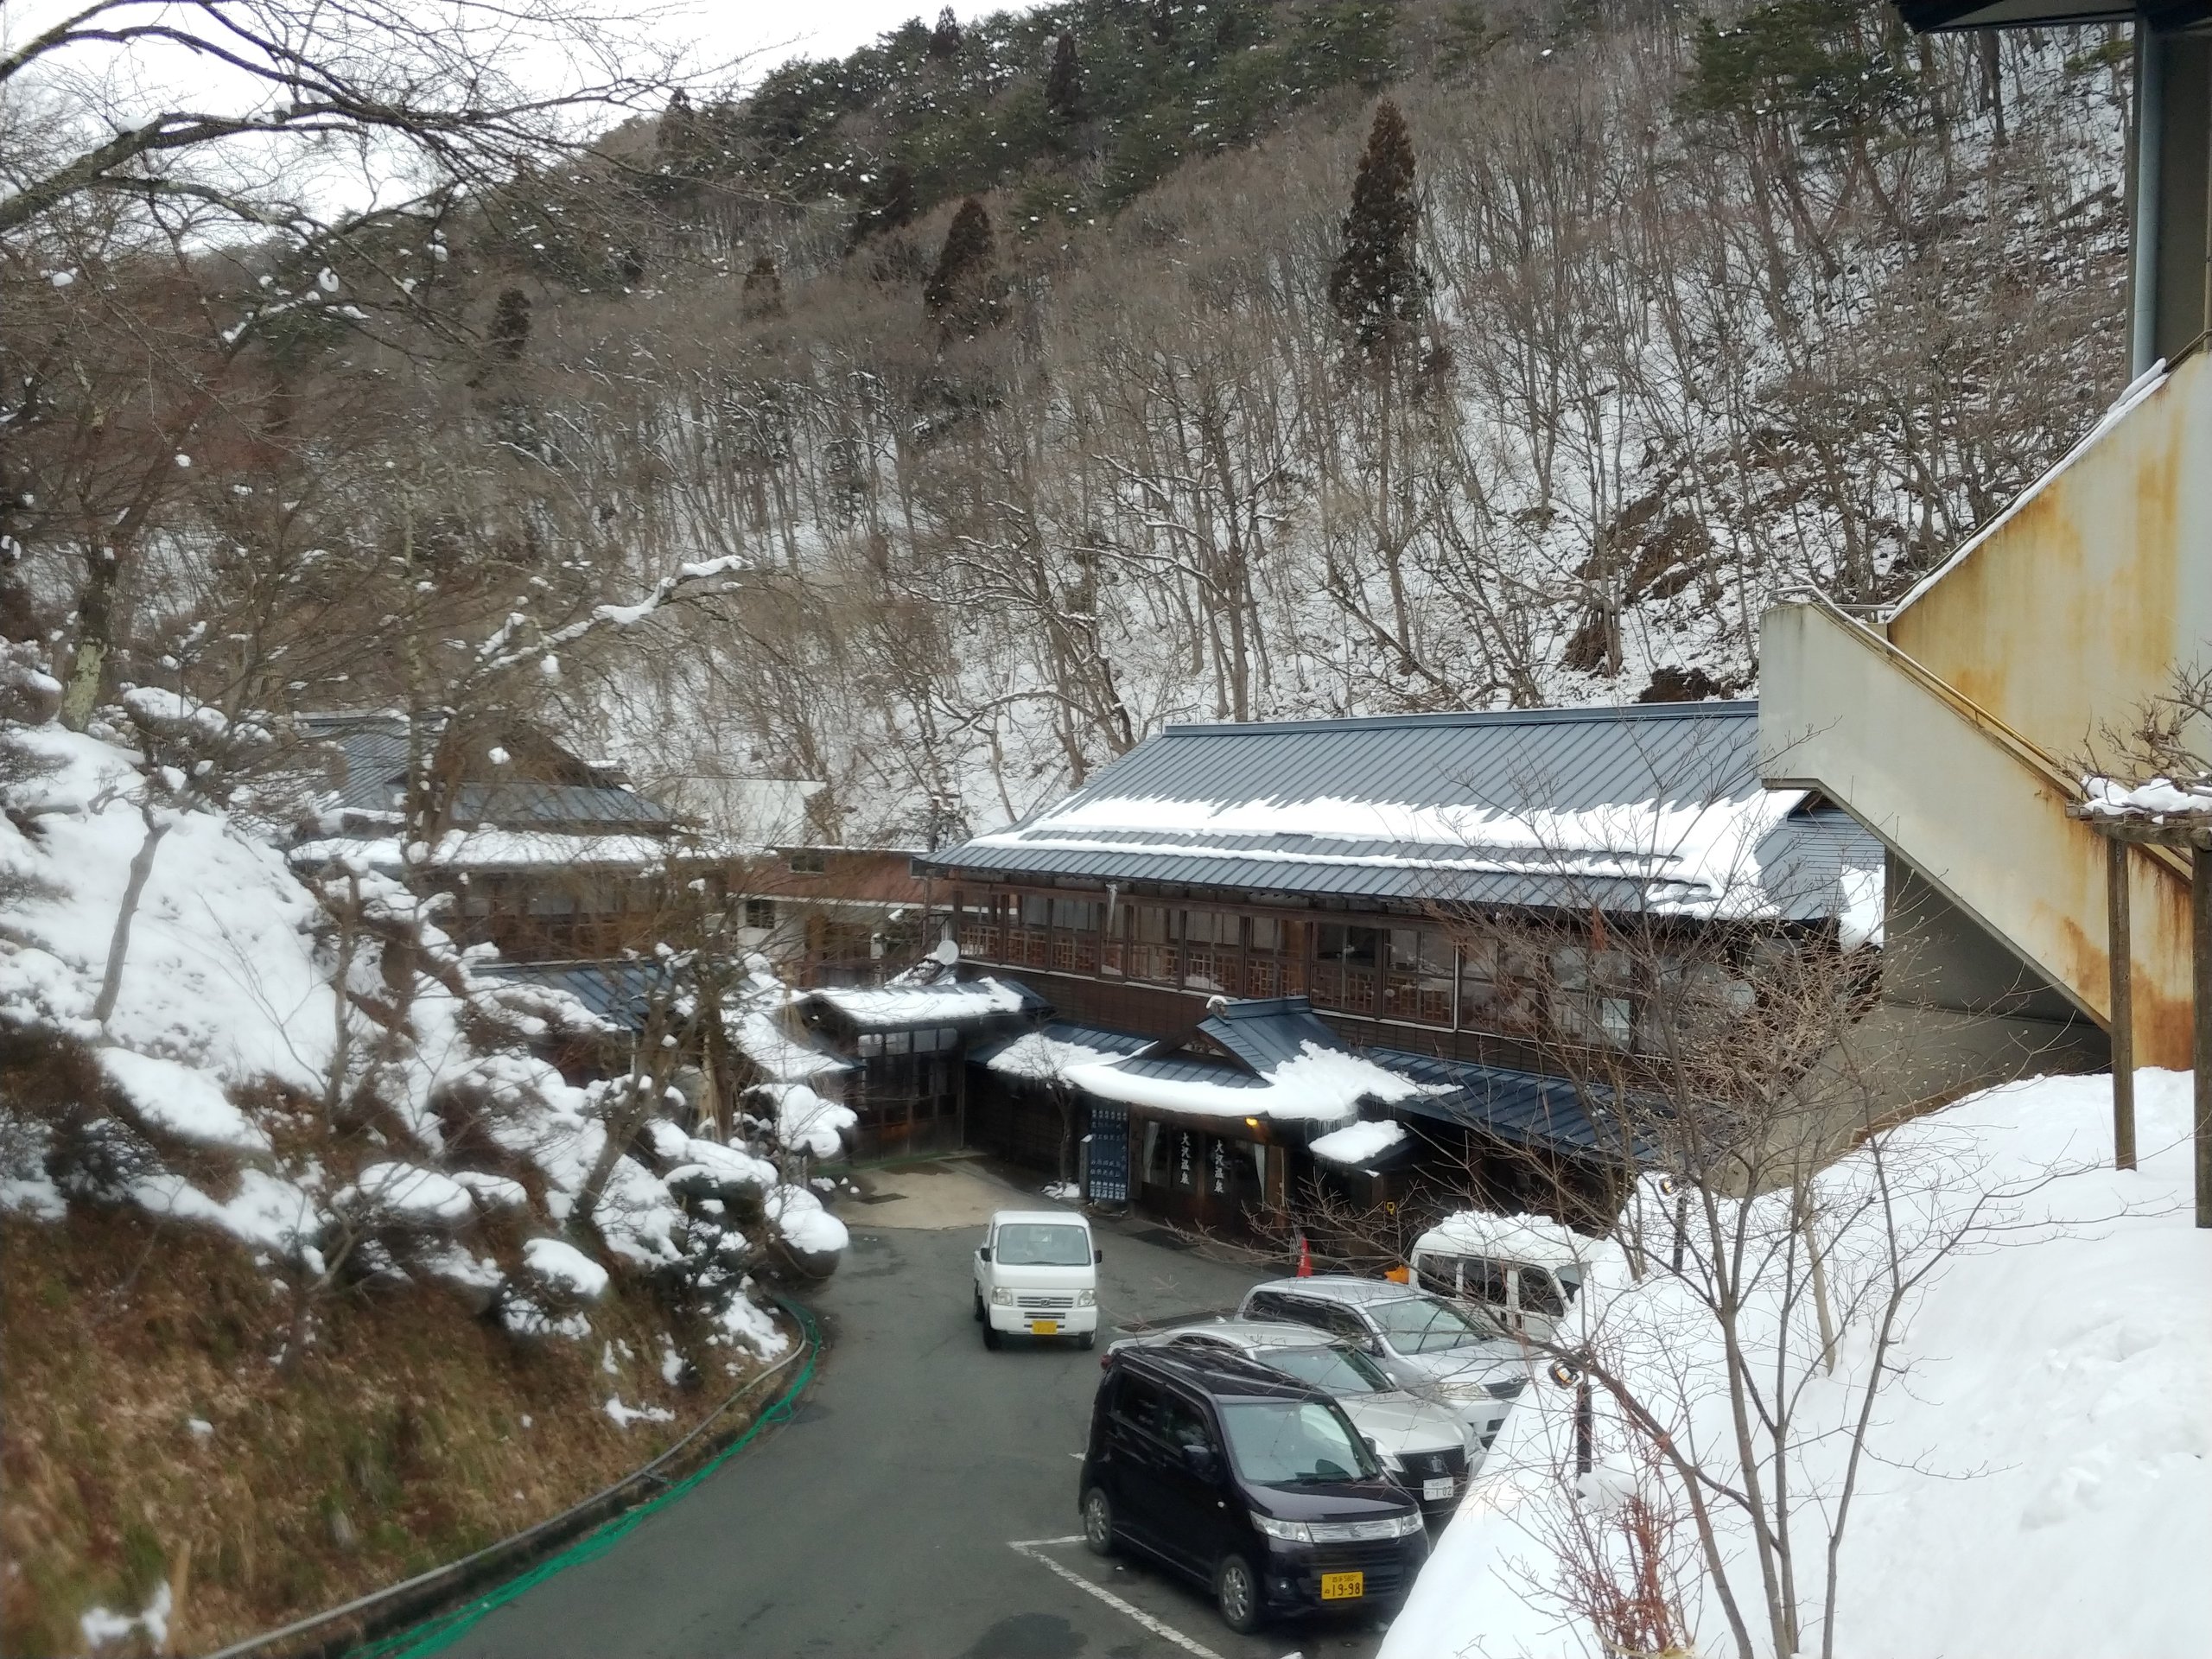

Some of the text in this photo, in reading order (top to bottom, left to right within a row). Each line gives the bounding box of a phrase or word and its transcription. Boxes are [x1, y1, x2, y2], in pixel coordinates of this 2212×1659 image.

[1180, 1132, 1191, 1185] 大沢温泉
[1214, 1139, 1224, 1193] 大沢温泉
[1332, 1582, 1360, 1597] 19-98
